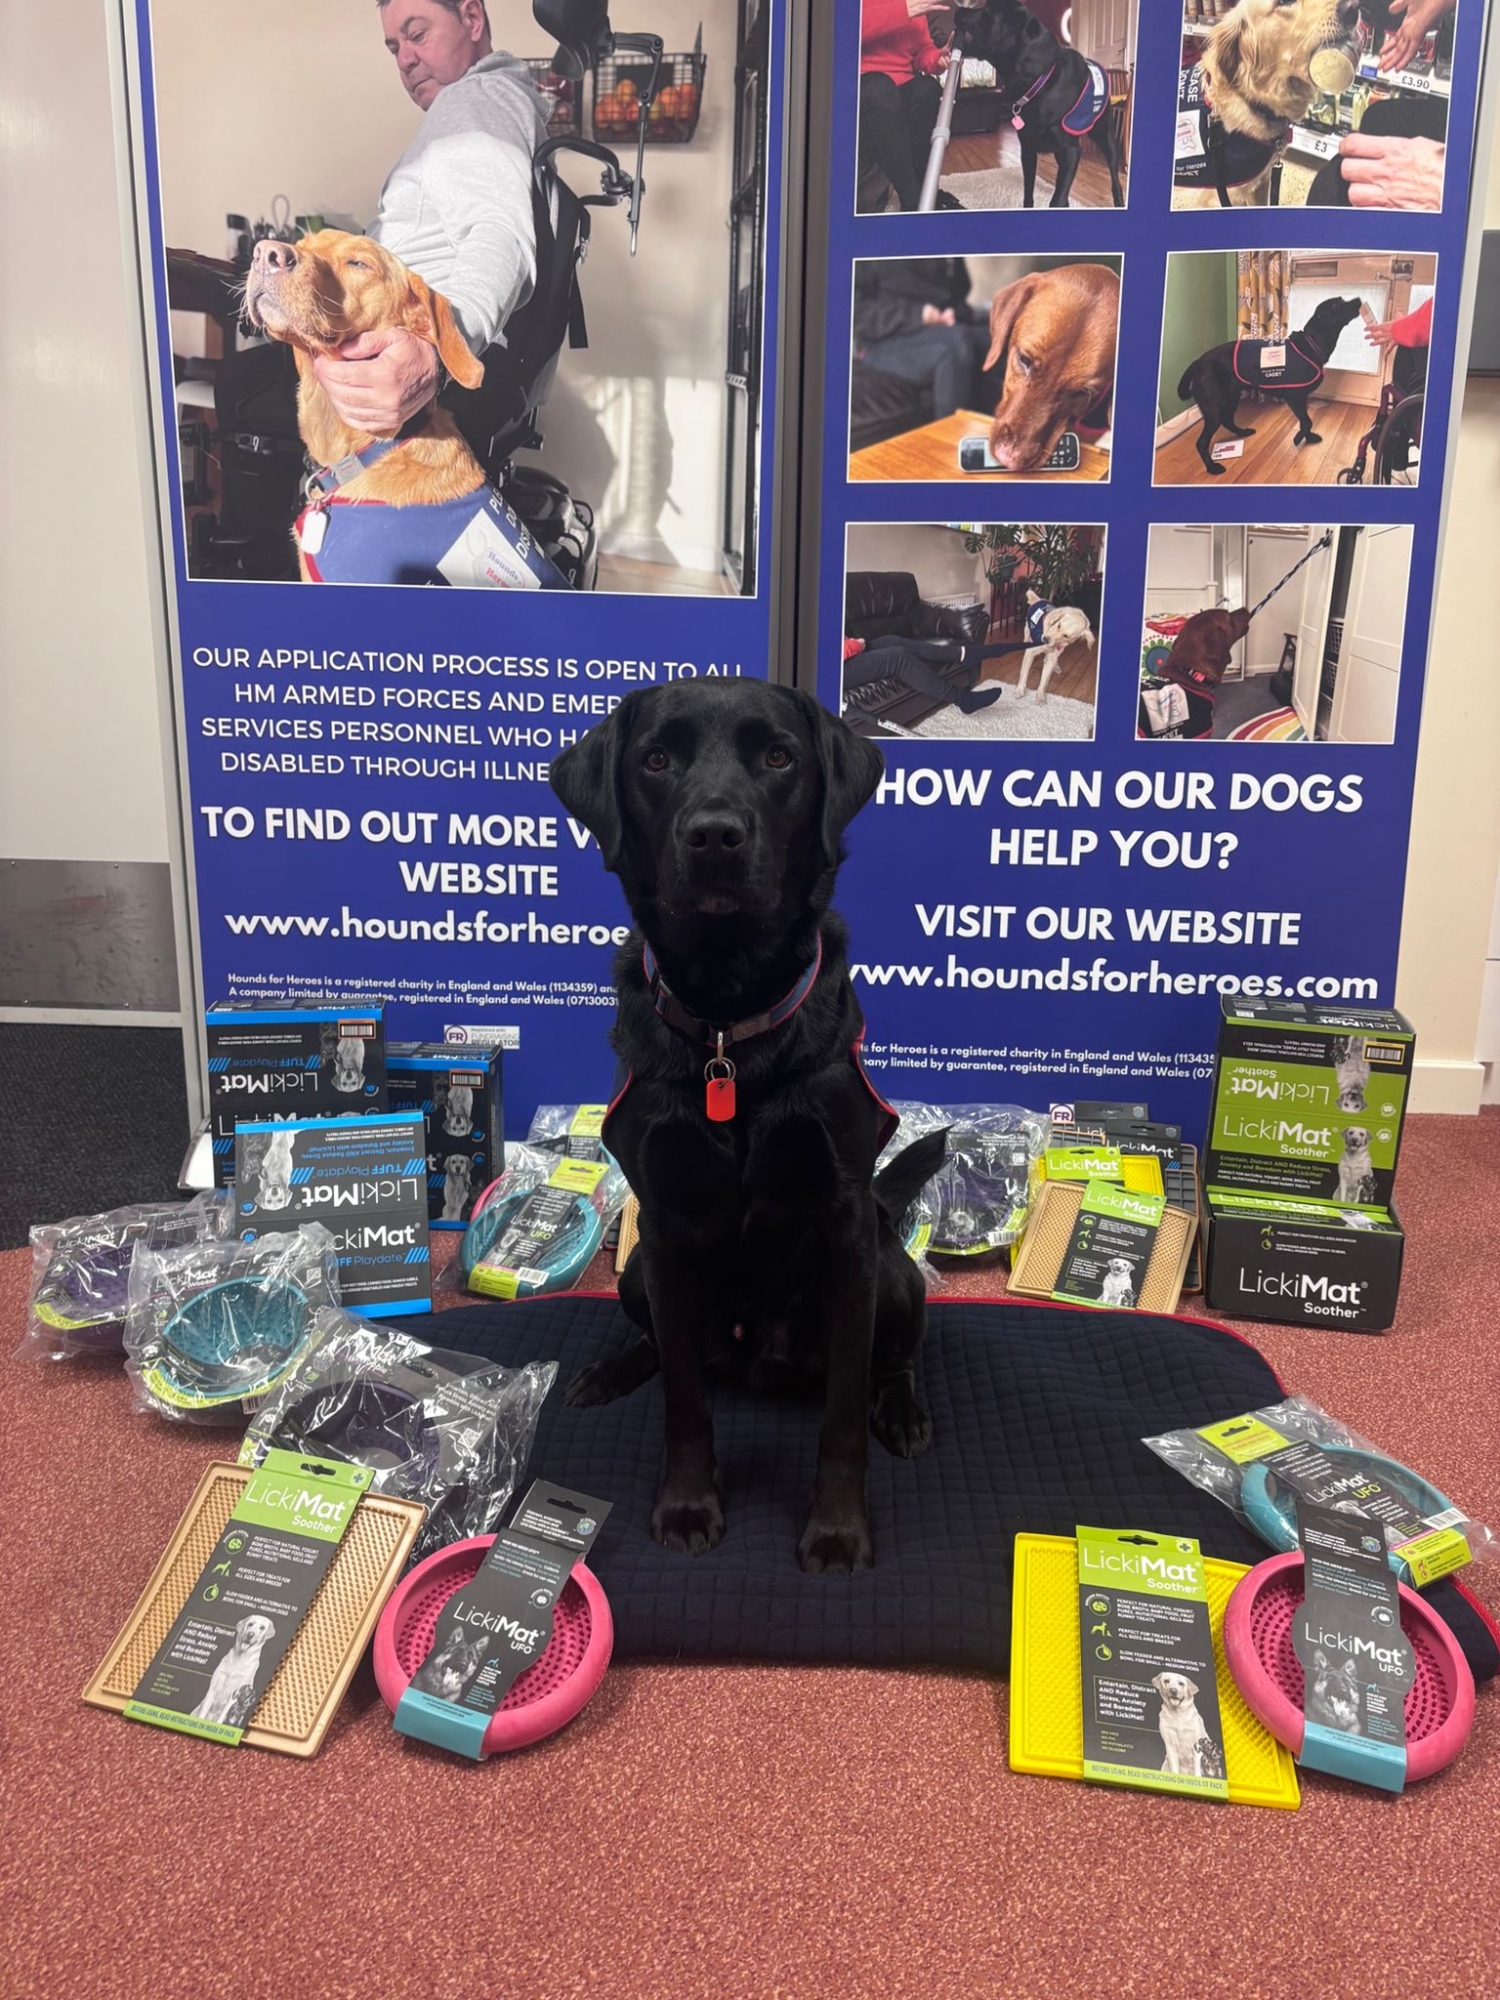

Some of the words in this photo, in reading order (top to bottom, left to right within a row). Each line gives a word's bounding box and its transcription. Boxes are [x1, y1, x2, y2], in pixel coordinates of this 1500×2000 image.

[1401, 75, 1430, 90] £3.90
[1314, 140, 1328, 153] £3
[488, 550, 519, 581] Hounds
[193, 647, 250, 668] OUR
[257, 649, 424, 673] APPLICATION
[432, 654, 549, 678] PROCESS
[557, 658, 578, 678] IS
[585, 659, 656, 681] OPEN
[663, 662, 697, 681] TO
[234, 683, 275, 703] HM
[282, 685, 376, 706] ARMED
[383, 687, 482, 710] FORCES
[487, 692, 545, 713] AND
[201, 717, 323, 739] SERVICES
[331, 721, 482, 745] PERSONNEL
[488, 726, 552, 748] WHO
[221, 752, 345, 774] DISABLED
[350, 756, 476, 779] THROUGH
[875, 768, 992, 806] HOW
[1002, 769, 1103, 809] CAN
[1114, 771, 1216, 811] OUR
[1230, 774, 1364, 814] DOGS
[201, 806, 255, 838] TO
[265, 807, 350, 841] FIND
[360, 810, 438, 844] OUT
[448, 813, 558, 849] MORE
[989, 828, 1098, 867] HELP
[1109, 829, 1239, 870] YOU?
[399, 860, 558, 896] WEBSITE
[915, 903, 1016, 939] VISIT
[1025, 906, 1114, 942] OUR
[1126, 908, 1302, 946] WEBSITE
[228, 973, 267, 984] Hounds
[269, 974, 283, 984] for
[286, 975, 322, 986] Heroes
[324, 976, 333, 986] is
[335, 978, 342, 987] a
[344, 978, 396, 989] registered
[398, 978, 434, 991] charity
[436, 980, 446, 990] in
[448, 980, 491, 993] England
[493, 981, 513, 991] and
[515, 981, 547, 992] Wales
[549, 982, 597, 994] (1134359)
[229, 987, 237, 996] A
[239, 988, 286, 999] company
[288, 988, 324, 999] limited
[326, 989, 338, 1000] by
[399, 991, 451, 1004] registered
[454, 994, 463, 1003] in
[466, 994, 508, 1006] England
[511, 995, 531, 1005] and
[533, 994, 564, 1005] Wales
[449, 1032, 464, 1042] FR
[278, 1056, 305, 1067] TUFF
[871, 1042, 887, 1053] for
[889, 1043, 927, 1054] Heroes
[930, 1045, 938, 1055] is
[940, 1047, 948, 1055] a
[951, 1046, 1007, 1058] registered
[1009, 1047, 1049, 1060] charity
[1051, 1049, 1061, 1059] in
[1064, 1049, 1109, 1062] England
[1112, 1051, 1134, 1061] and
[1137, 1051, 1171, 1063] Wales
[890, 1057, 928, 1069] limited
[930, 1059, 944, 1071] by
[946, 1061, 1007, 1072] guarantee,
[1010, 1063, 1067, 1074] registered
[1069, 1063, 1080, 1073] in
[1083, 1064, 1128, 1077] England
[1130, 1065, 1153, 1076] and
[1155, 1066, 1190, 1078] Wales
[1233, 1066, 1277, 1078] Soother
[220, 1072, 319, 1095] LickiMat
[1230, 1077, 1330, 1106] LickiMat
[1053, 1111, 1070, 1122] FR
[1223, 1115, 1331, 1147] LickiMat
[1280, 1144, 1329, 1158] Soother
[316, 1165, 369, 1178] Playdate
[371, 1164, 402, 1176] TUFF
[1050, 1158, 1119, 1171] LickiMat
[301, 1177, 418, 1208] LickiMat
[1086, 1189, 1157, 1217] LickiMat
[510, 1214, 559, 1233] LickiMat
[530, 1230, 553, 1240] UFO
[353, 1253, 403, 1266] Playdate
[1239, 1266, 1361, 1305] LickiMat
[1303, 1301, 1359, 1319] Soother
[1307, 1473, 1369, 1503] LickiMat
[1352, 1482, 1381, 1500] UFO
[245, 1478, 346, 1523] LickiMat
[292, 1515, 338, 1534] Soother
[1083, 1547, 1197, 1583] LickiMat
[1147, 1578, 1198, 1594] Soother
[453, 1601, 540, 1646] LickiMat
[510, 1640, 533, 1655] UFO
[1305, 1622, 1403, 1667] LickiMat
[1378, 1662, 1404, 1677] UFO
[1099, 1679, 1130, 1690] Entertain,
[1131, 1684, 1157, 1693] Distract
[1115, 1689, 1139, 1698] Reduce
[1099, 1694, 1121, 1703] Stress,
[1122, 1698, 1147, 1707] Anxiety
[1113, 1703, 1143, 1713] Boredom
